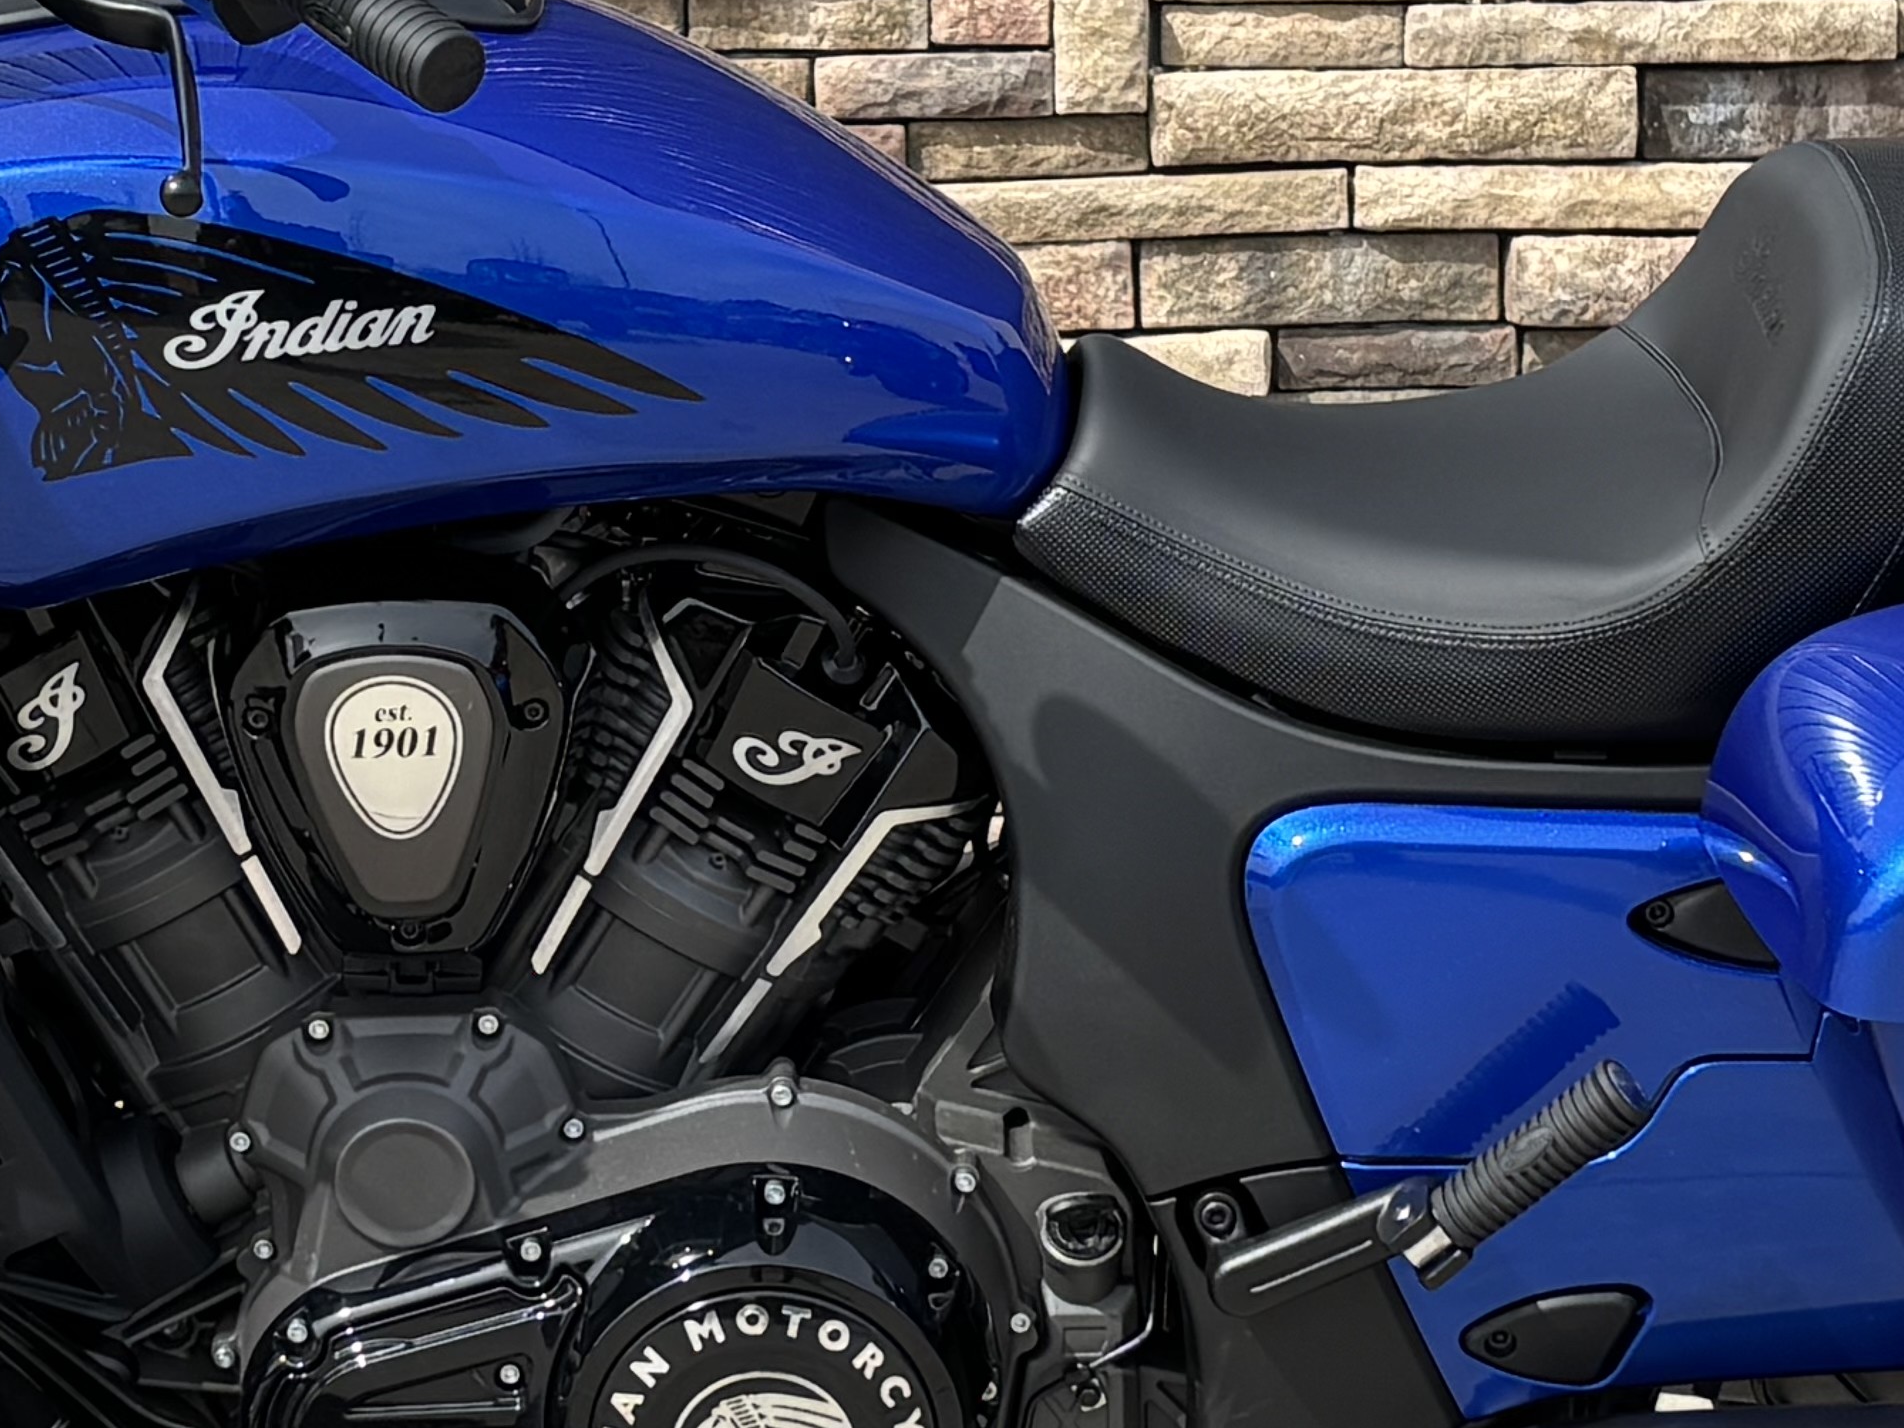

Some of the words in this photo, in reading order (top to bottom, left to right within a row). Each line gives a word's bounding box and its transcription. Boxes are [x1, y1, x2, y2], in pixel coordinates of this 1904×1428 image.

[162, 288, 436, 371] Indian
[374, 704, 414, 723] est.
[352, 725, 439, 760] 1901
